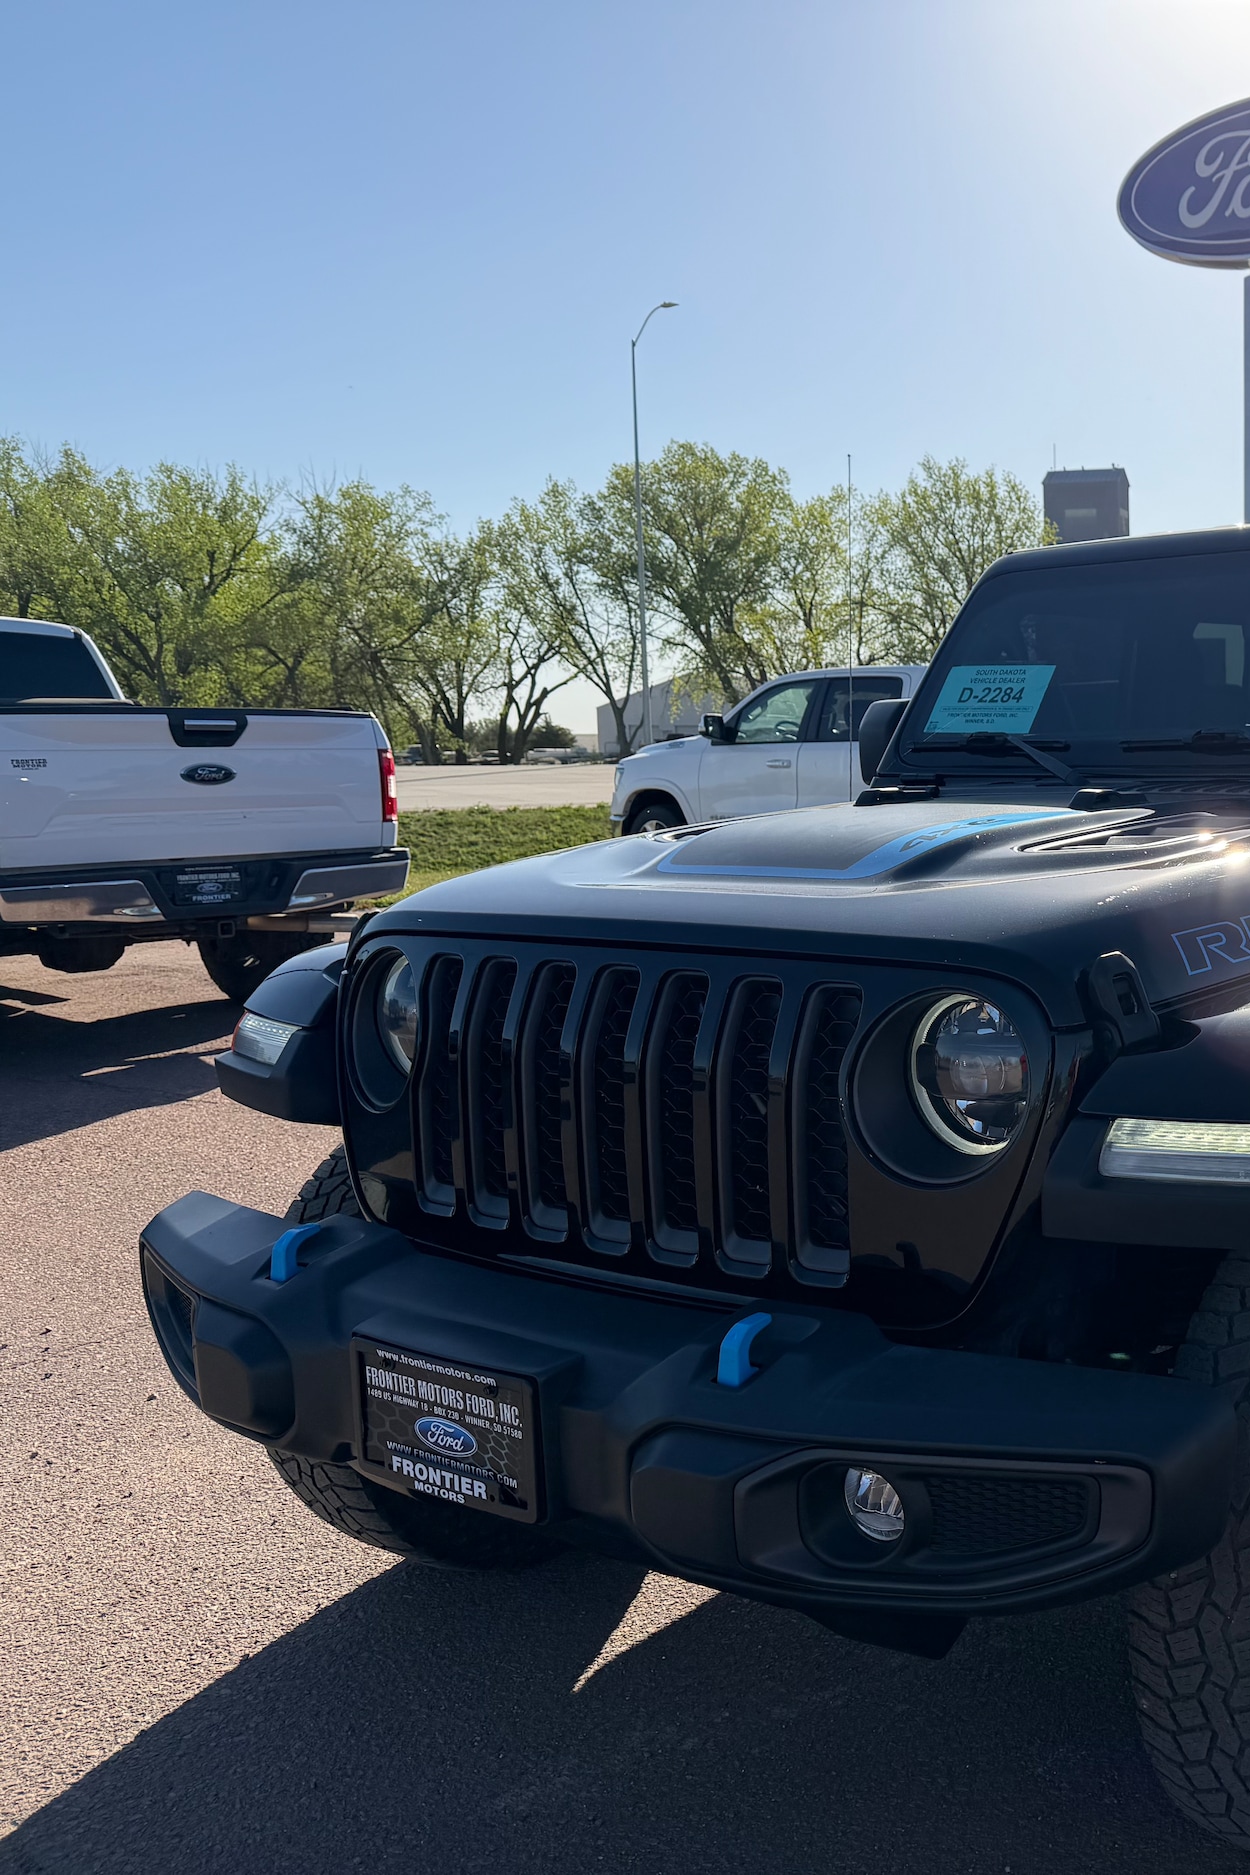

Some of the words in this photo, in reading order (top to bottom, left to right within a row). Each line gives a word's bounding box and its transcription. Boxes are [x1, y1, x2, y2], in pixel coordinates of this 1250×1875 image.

[957, 687, 1025, 703] D-2284
[194, 767, 225, 780] Ford
[376, 1349, 497, 1387] www.frontiermotors.com
[365, 1366, 416, 1396] FRONTIER
[417, 1380, 464, 1410] MOTORS
[383, 1391, 391, 1401] US
[427, 1421, 465, 1451] Ford
[391, 1455, 487, 1500] FRONTIER
[414, 1480, 466, 1505] MOTORS
